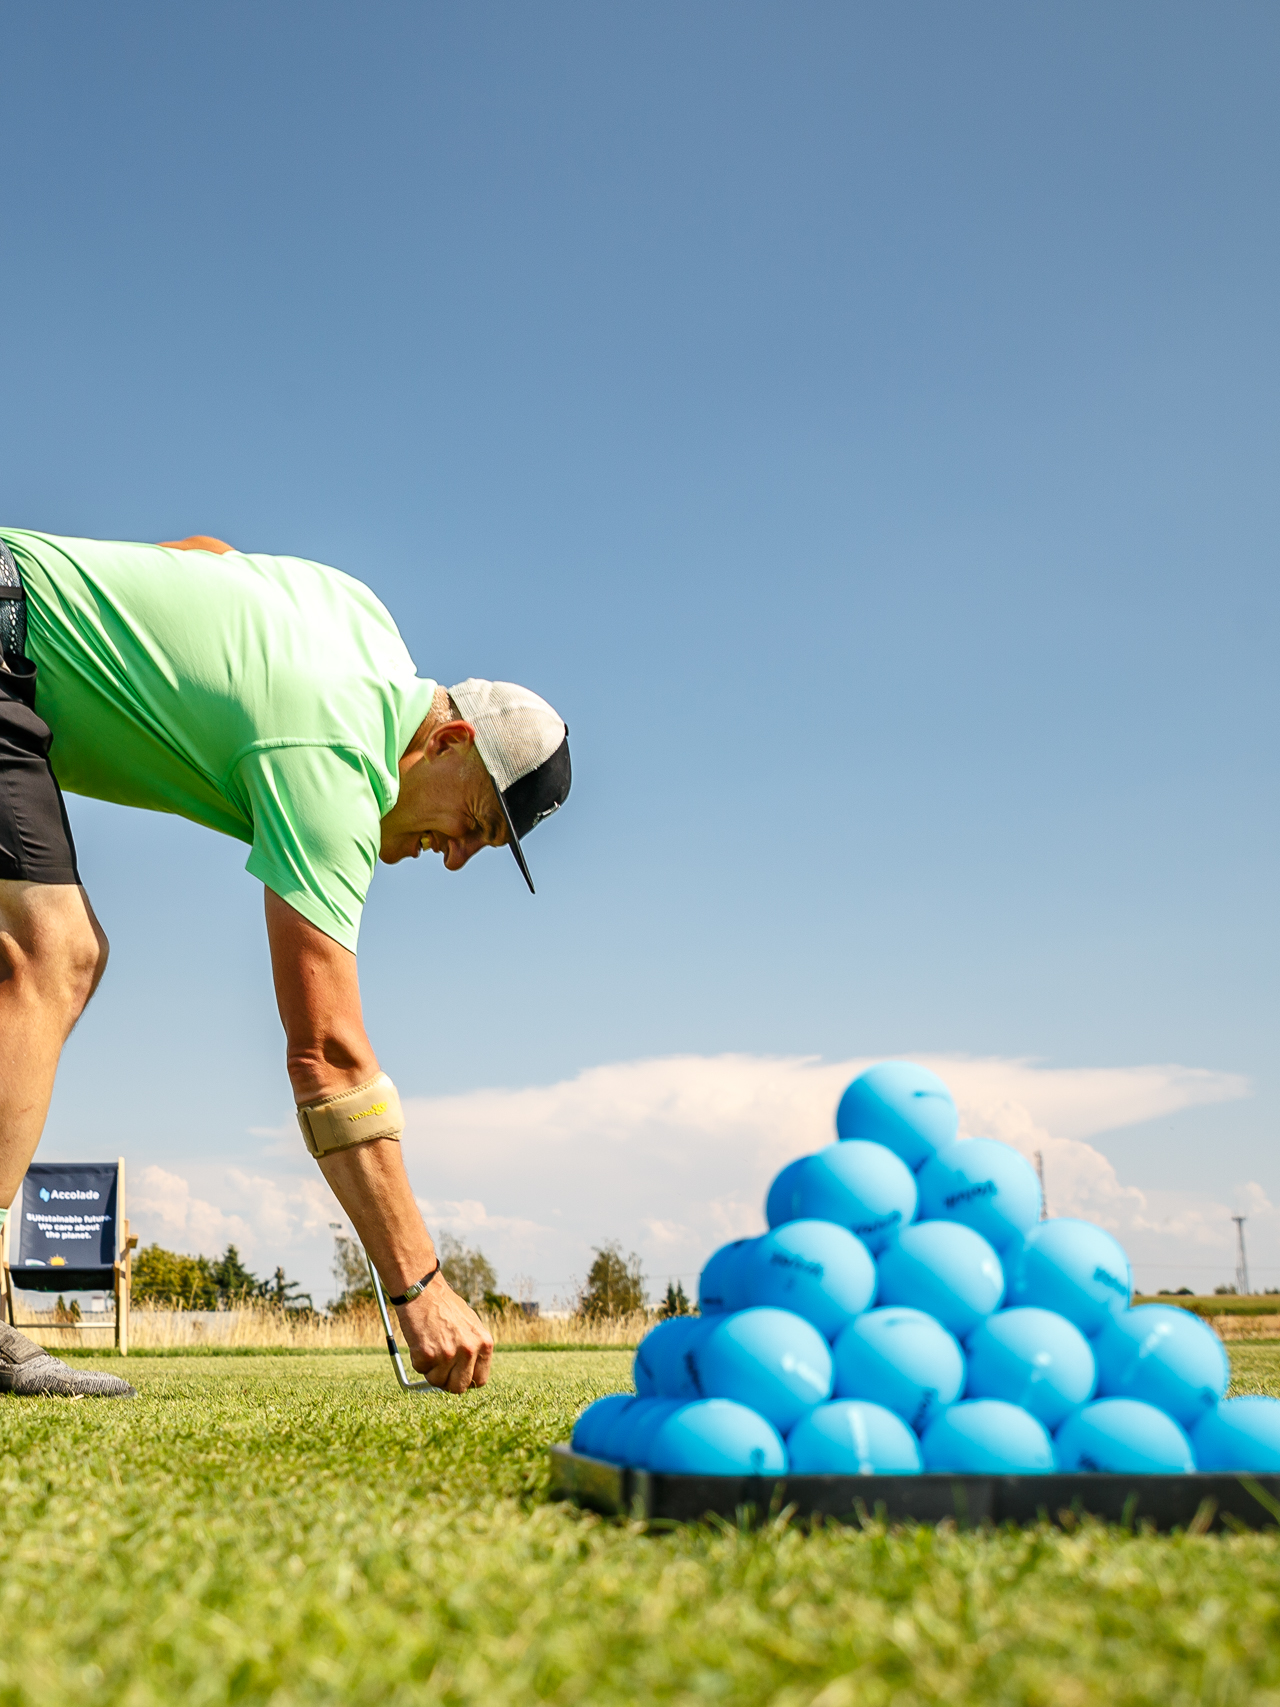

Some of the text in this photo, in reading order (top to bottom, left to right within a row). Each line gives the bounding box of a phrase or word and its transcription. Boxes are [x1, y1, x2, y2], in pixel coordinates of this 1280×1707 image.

[50, 1189, 100, 1200] Accolade
[25, 1212, 83, 1223] SUNstainable
[37, 1222, 100, 1232] We care about
[45, 1230, 60, 1239] the
